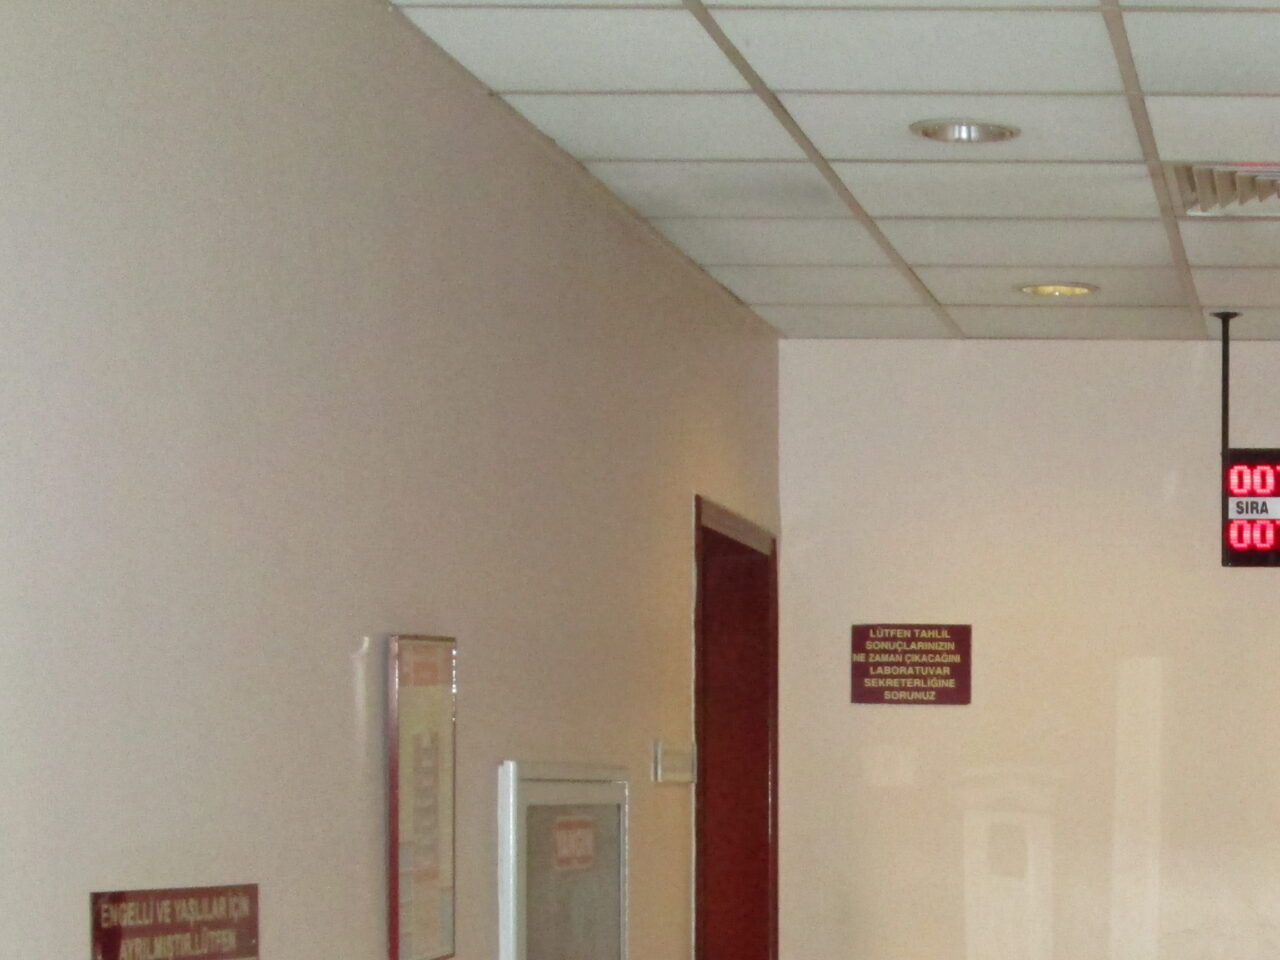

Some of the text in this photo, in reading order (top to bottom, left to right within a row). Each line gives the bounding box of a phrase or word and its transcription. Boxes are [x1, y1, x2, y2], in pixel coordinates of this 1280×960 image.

[1236, 501, 1269, 514] SIRA
[869, 627, 911, 638] LÜTFEN
[865, 641, 956, 652] SONUÇLARINIZIN
[852, 653, 866, 662] NE
[868, 653, 903, 662] ZAMAN
[869, 666, 951, 675] LABORATUVAR
[883, 691, 937, 700] SORUNUZ
[156, 900, 171, 923] VE
